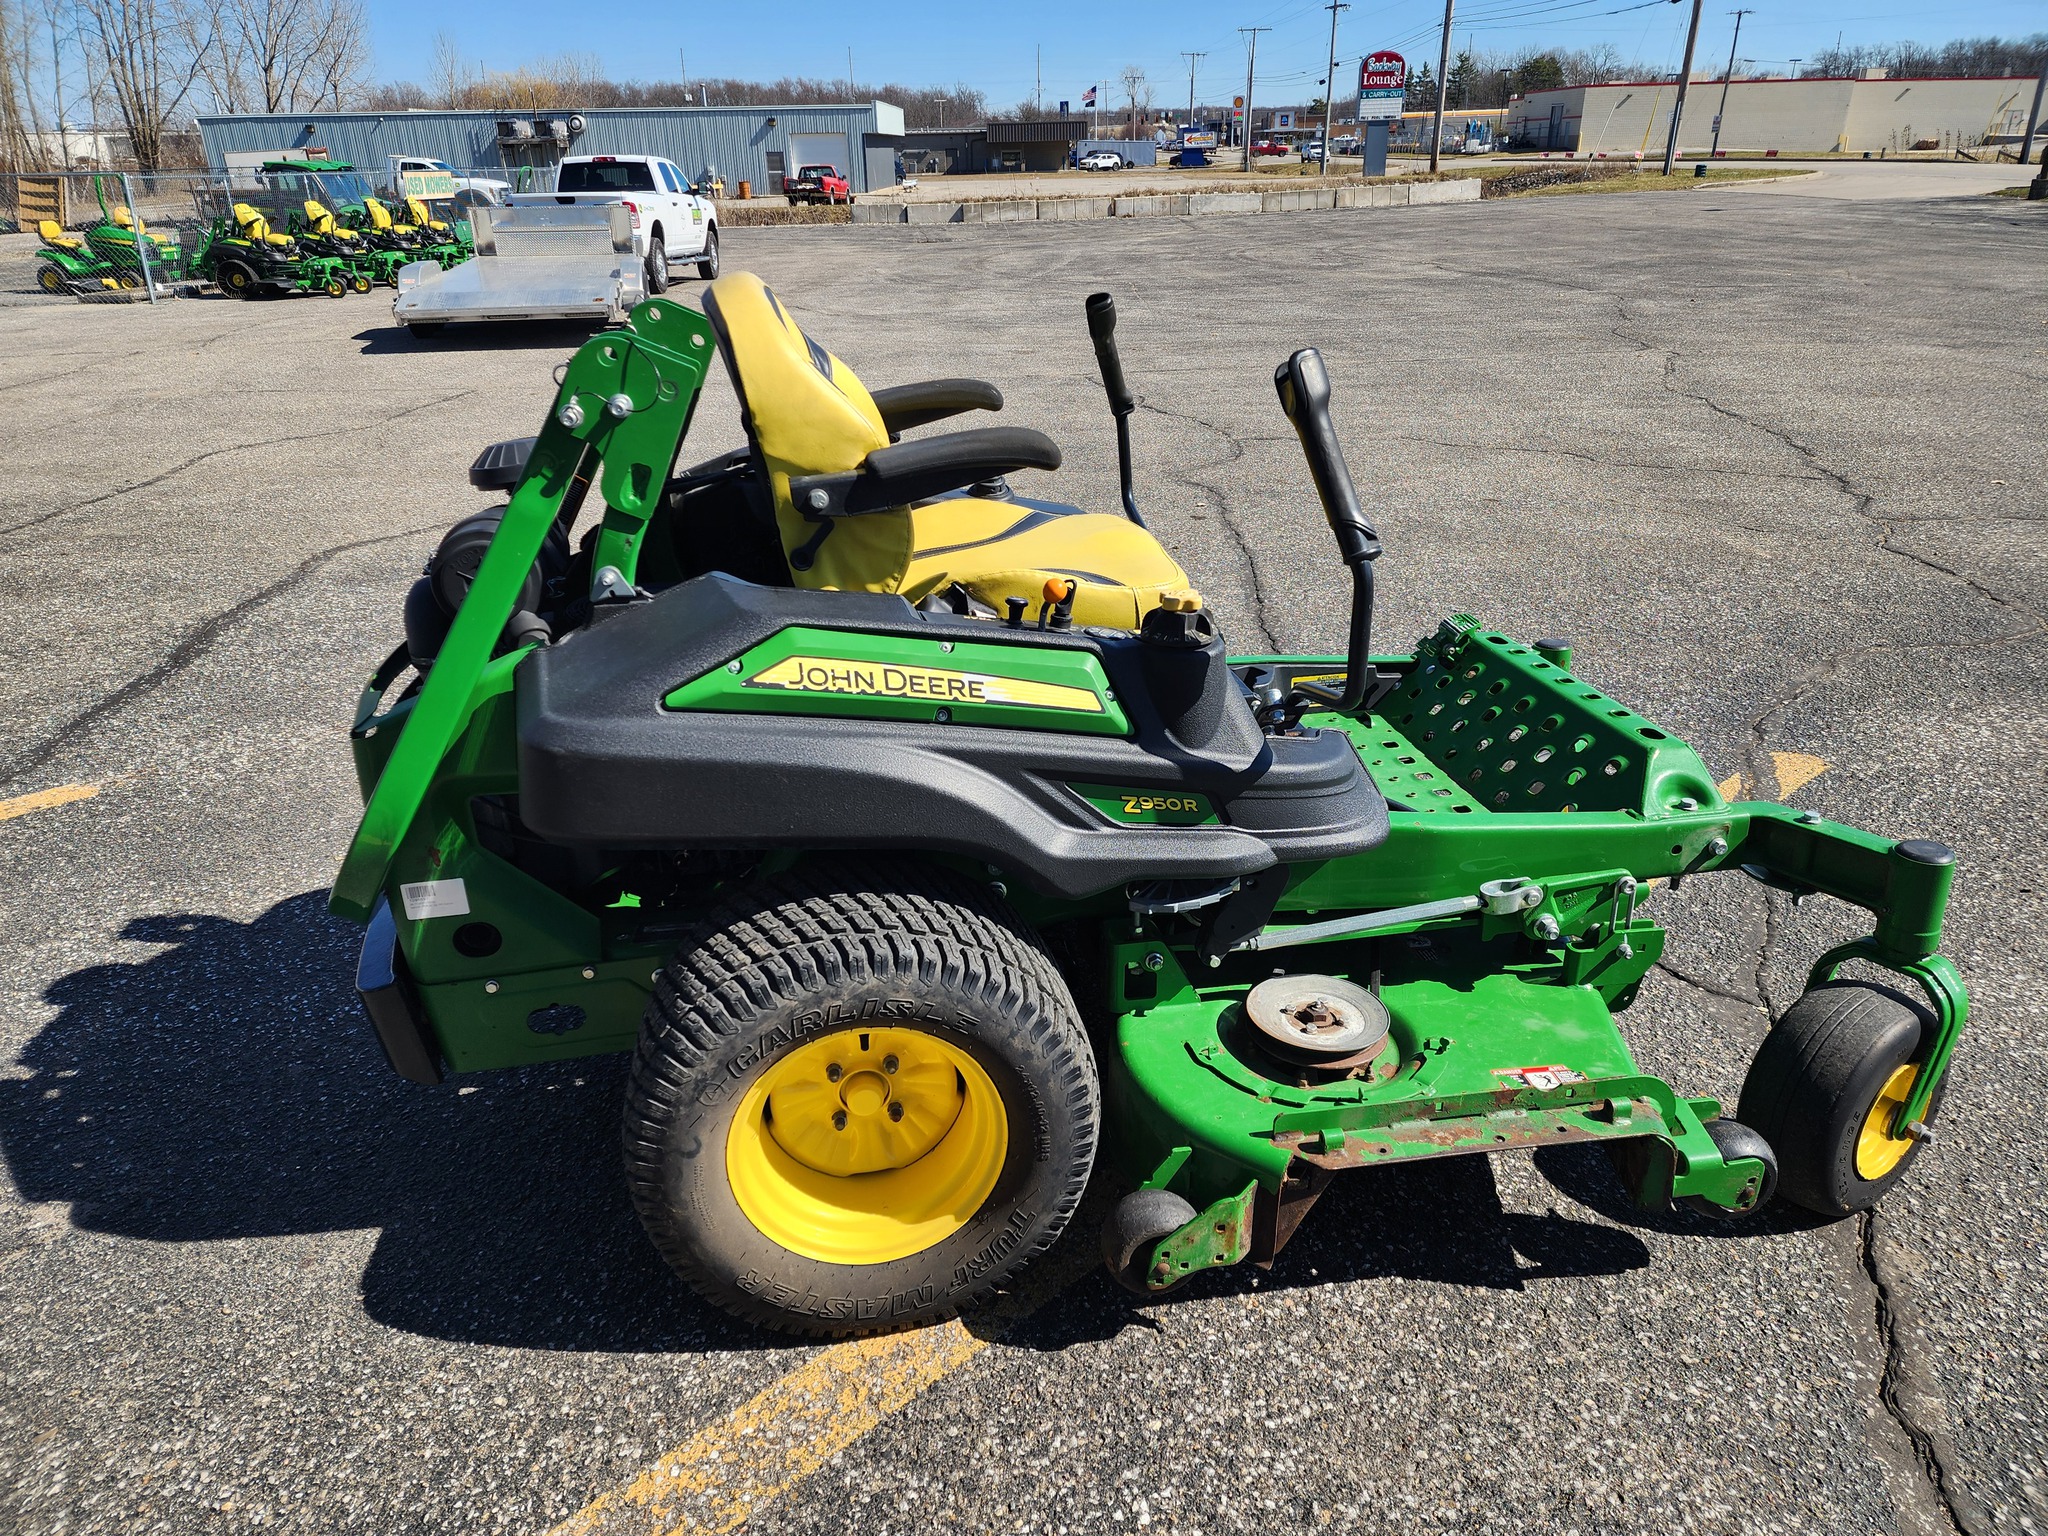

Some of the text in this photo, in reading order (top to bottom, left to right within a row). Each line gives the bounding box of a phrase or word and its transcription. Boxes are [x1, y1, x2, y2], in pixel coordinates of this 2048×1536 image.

[1363, 73, 1403, 88] Lounge
[1368, 90, 1402, 98] CARRY-OUT
[405, 176, 453, 195] USED MOWERS
[788, 662, 986, 699] JOHN DEERE
[727, 997, 981, 1079] CARLISLE
[735, 1208, 1038, 1321] TURF MASTER
